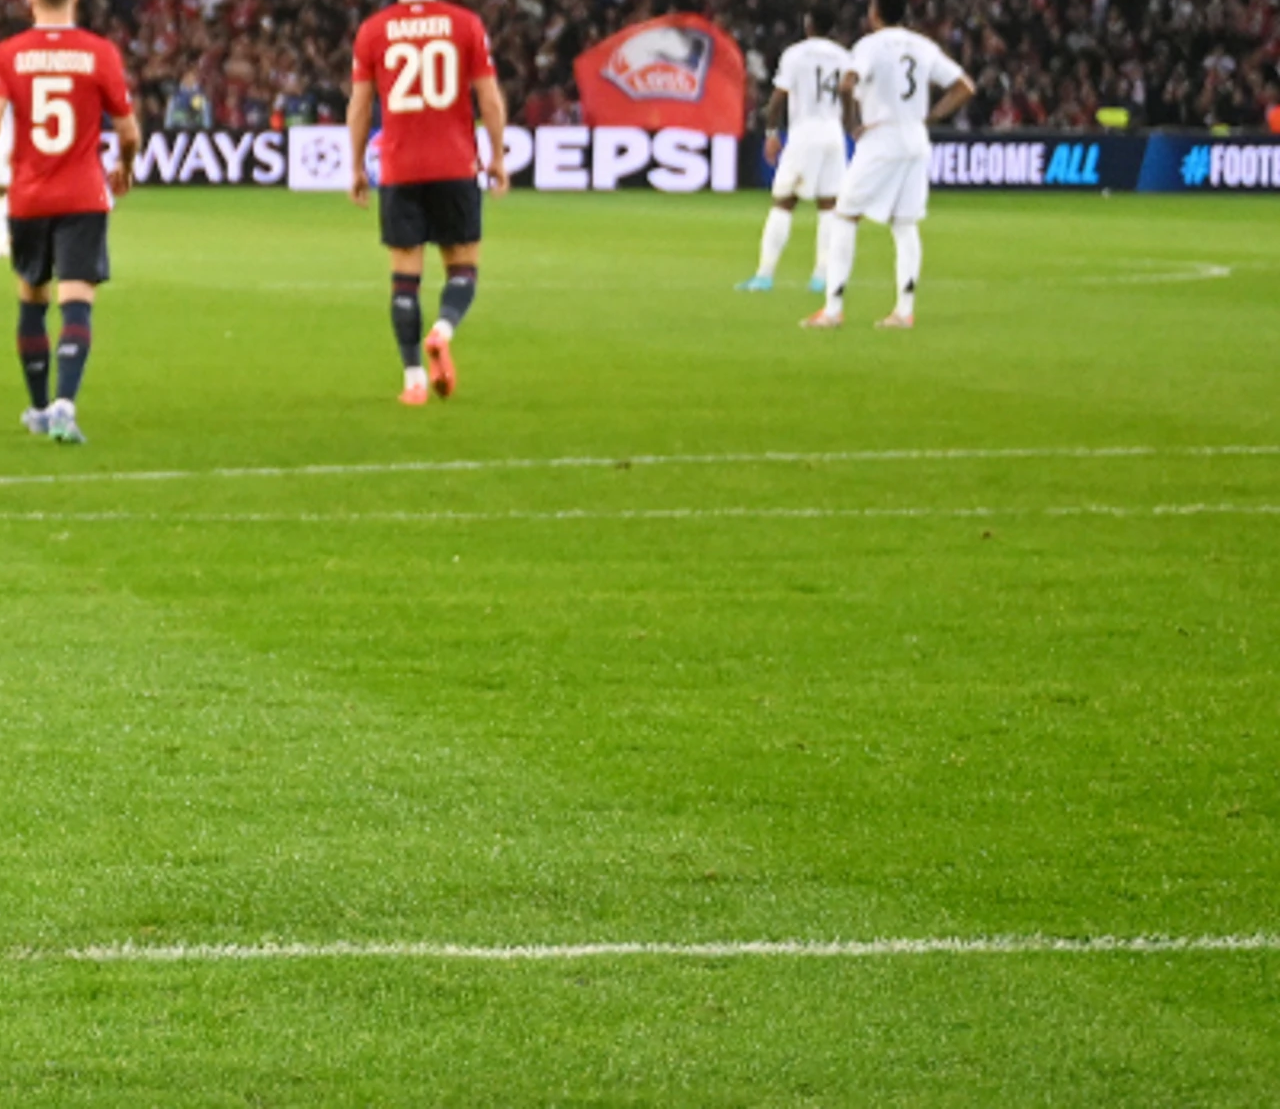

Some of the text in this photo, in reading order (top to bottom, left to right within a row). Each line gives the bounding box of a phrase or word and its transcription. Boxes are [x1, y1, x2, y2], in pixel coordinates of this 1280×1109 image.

[384, 39, 458, 113] 20
[900, 55, 917, 102] 3
[31, 75, 76, 155] 5
[475, 125, 738, 193] PEPSI
[1045, 142, 1101, 185] ALL
